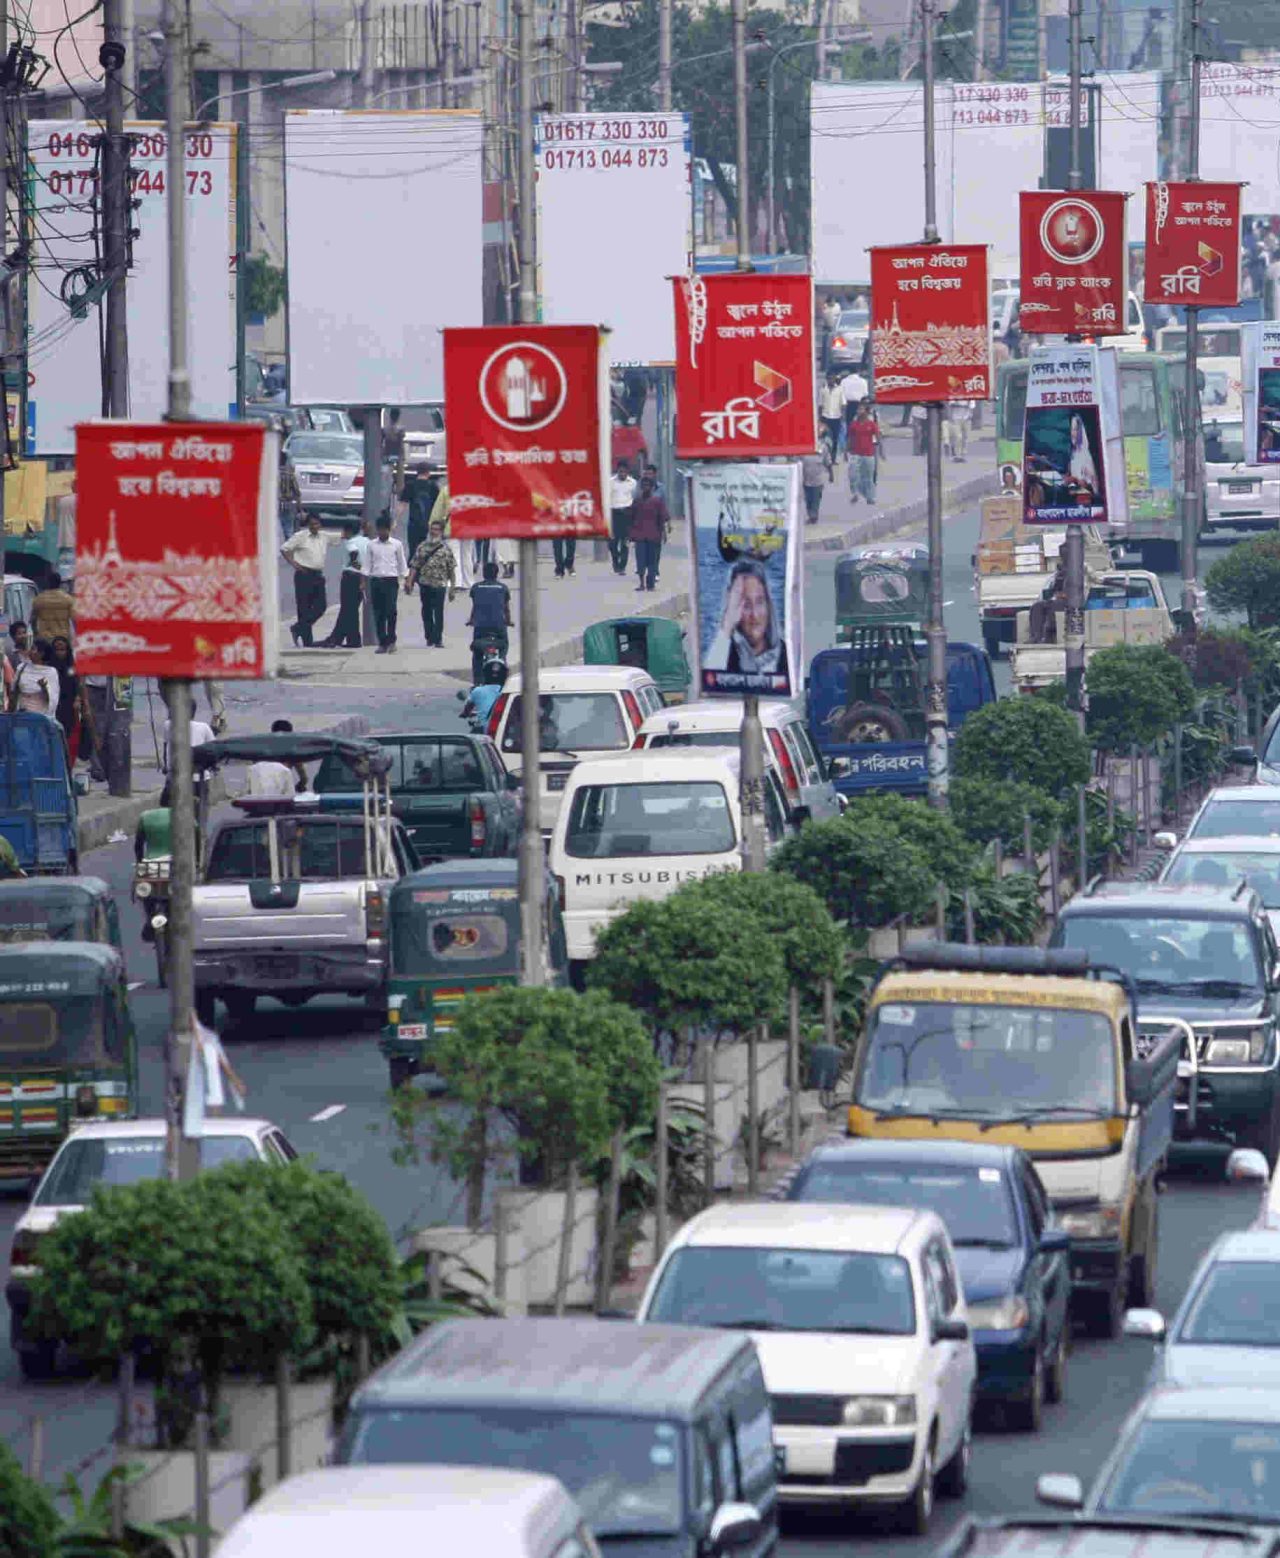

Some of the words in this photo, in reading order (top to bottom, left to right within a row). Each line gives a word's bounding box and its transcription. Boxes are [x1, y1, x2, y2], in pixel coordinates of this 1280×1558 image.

[977, 87, 1001, 102] 330
[1005, 87, 1029, 102] 330
[977, 109, 1001, 124] 044
[1004, 109, 1029, 124] 873
[545, 120, 596, 141] 01617
[601, 121, 632, 140] 330
[637, 120, 668, 139] 330
[545, 149, 597, 170] 01713
[601, 149, 633, 168] 044
[637, 148, 669, 167] 873
[186, 170, 213, 196] 73
[1181, 202, 1203, 214] জ্বলে
[1206, 200, 1226, 215] উঠুন
[1174, 216, 1200, 226] আপন
[891, 257, 925, 269] আপন
[928, 252, 969, 268] ঐতিহ্যে
[896, 279, 919, 292] হবে
[921, 275, 962, 292] বিশ্বজয়
[1032, 272, 1052, 289] রবি
[1055, 276, 1076, 291] ব্লাড
[1080, 276, 1112, 289] ব্যাংক
[1160, 265, 1201, 296] রবি
[726, 303, 758, 321] জ্বলে
[761, 300, 792, 320] উঠুন
[1092, 303, 1116, 322] রবি
[716, 325, 756, 339] আপন
[759, 321, 803, 339] শক্তিতে
[963, 374, 986, 393] রবি
[700, 397, 760, 444] রবি
[110, 440, 164, 460] আপন
[169, 437, 234, 463] ঐতিহ্যে
[463, 447, 489, 467] রবি
[117, 476, 153, 497] হবে
[156, 470, 222, 498] বিশ্বজয়
[558, 490, 595, 520] রবি
[221, 637, 257, 667] রবি
[861, 753, 925, 773] পরিবহন
